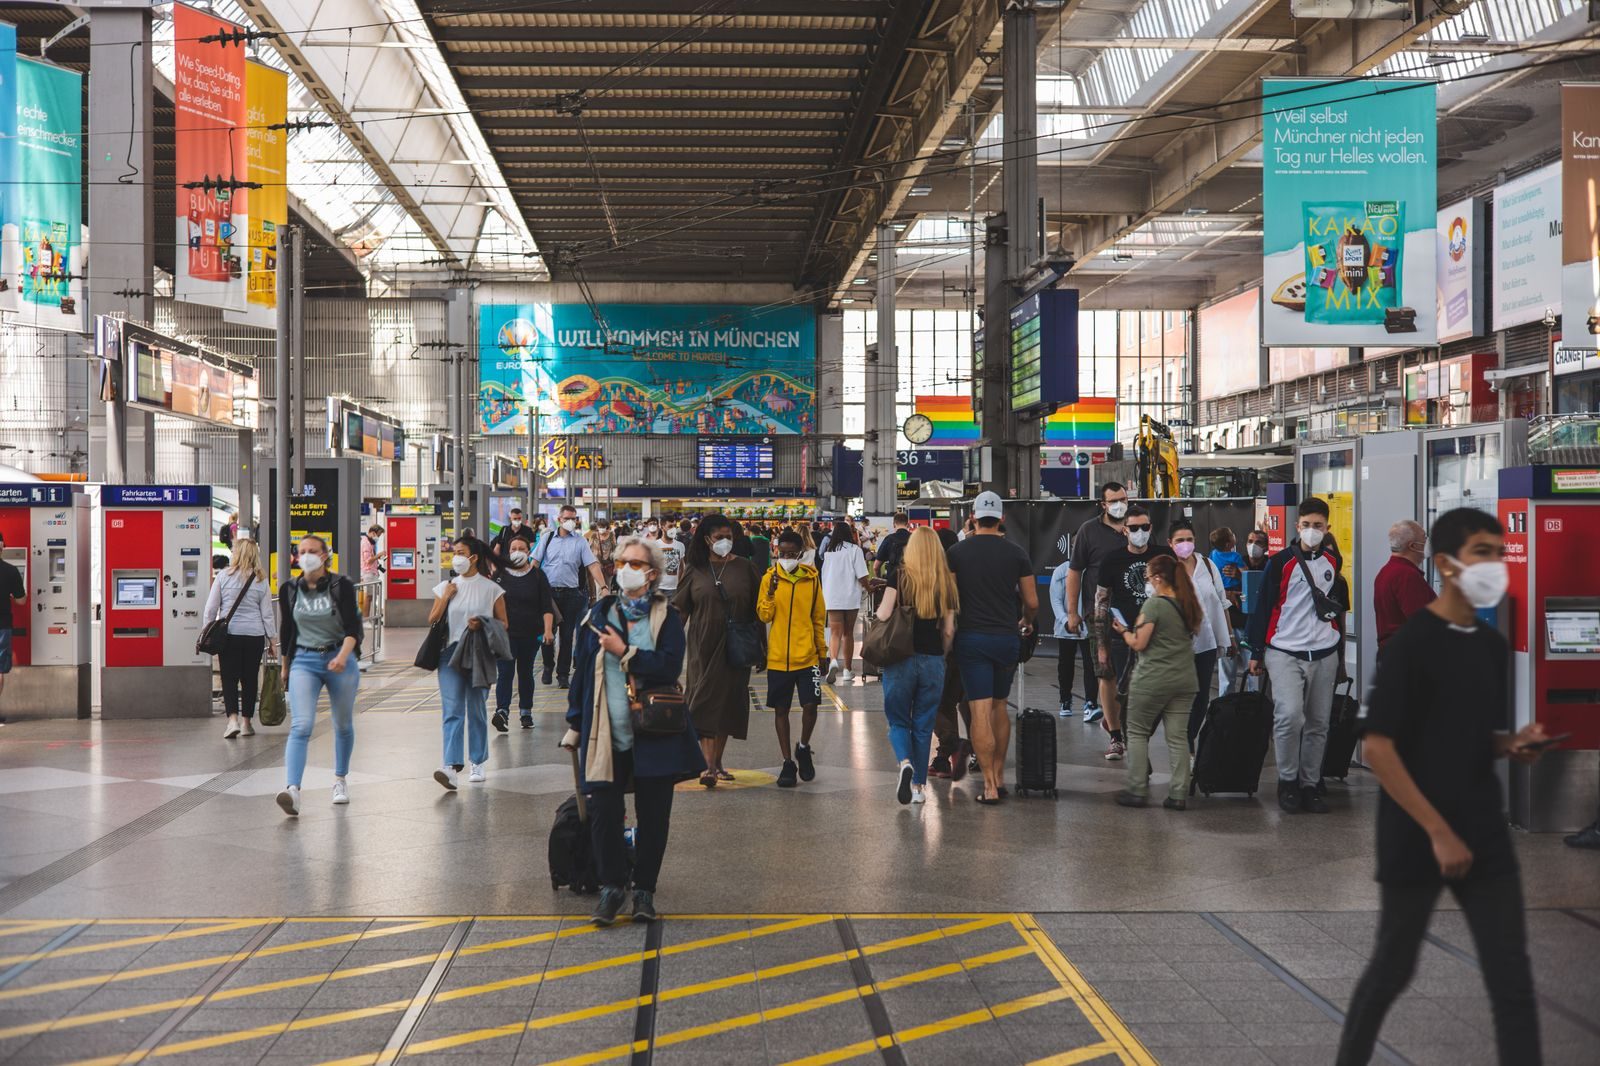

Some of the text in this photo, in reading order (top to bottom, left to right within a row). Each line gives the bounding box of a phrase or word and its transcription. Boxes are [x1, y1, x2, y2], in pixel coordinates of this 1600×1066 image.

[178, 52, 194, 70] Wie
[193, 74, 209, 92] dass
[210, 80, 221, 95] Sie
[222, 86, 234, 100] sich
[234, 90, 240, 102] in
[179, 88, 222, 112] alle verlieben.
[24, 104, 48, 121] echte
[1273, 106, 1348, 124] Weil selbst
[1274, 126, 1424, 148] Münchner nicht jeden
[1274, 146, 1427, 168] Tag nur Helles wollen.
[1368, 203, 1383, 213] NEU
[1309, 216, 1398, 236] KAKAO
[1344, 268, 1363, 277] mini
[1326, 286, 1381, 310] MIX
[558, 328, 800, 348] WILLKOMMEN IN MÜNCHEN
[1556, 351, 1581, 365] CHANGE
[1548, 521, 1560, 530] DB
